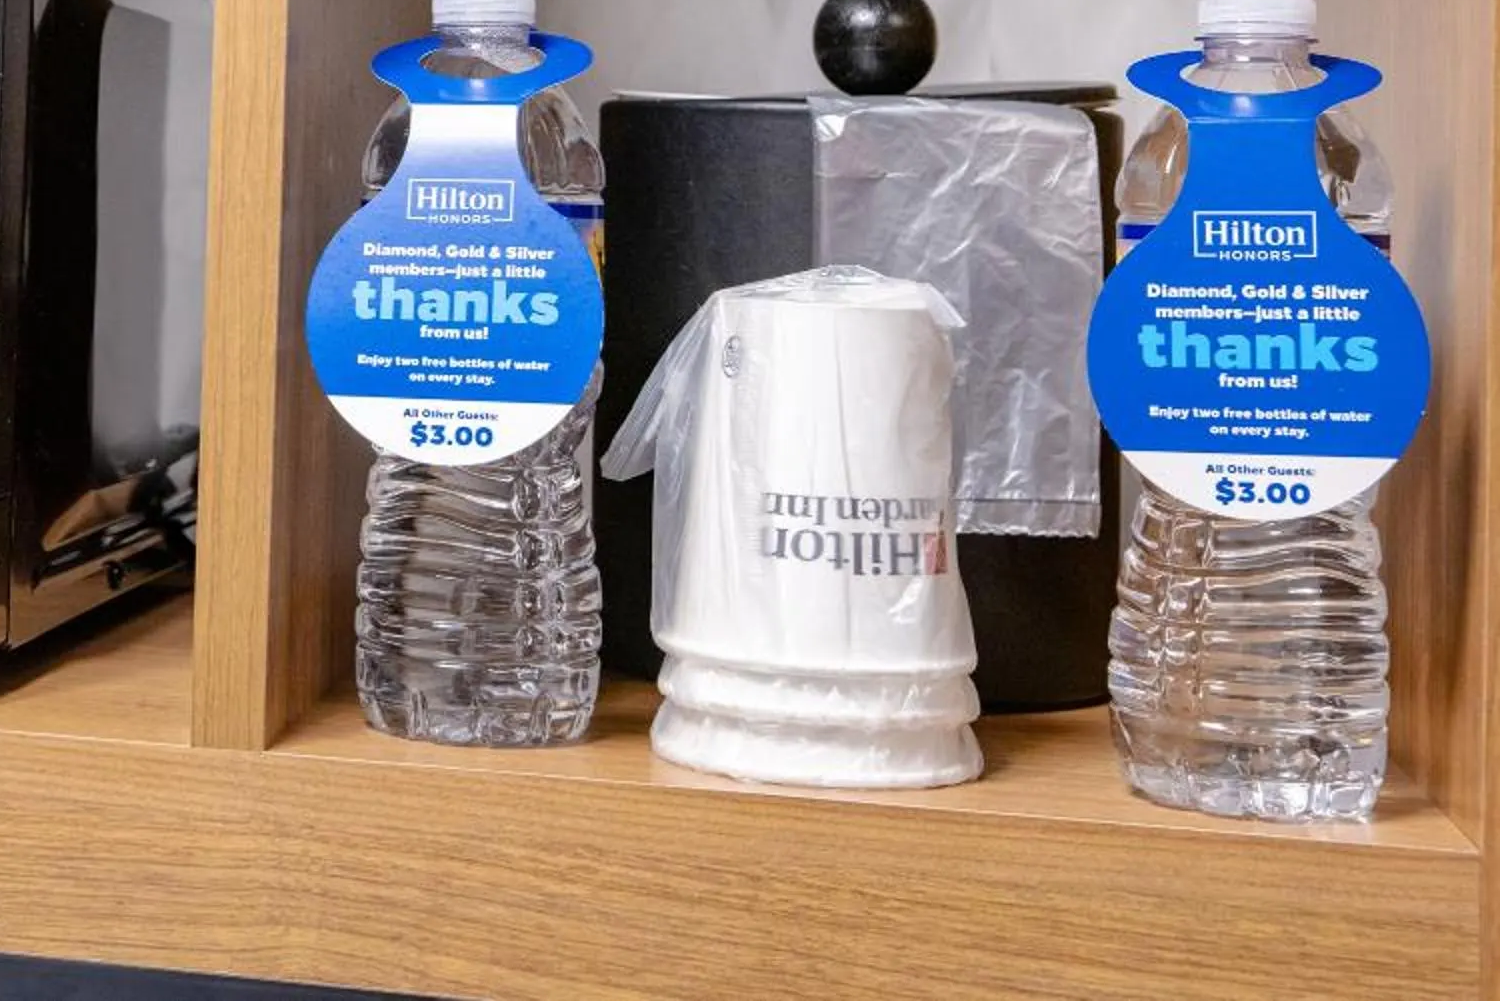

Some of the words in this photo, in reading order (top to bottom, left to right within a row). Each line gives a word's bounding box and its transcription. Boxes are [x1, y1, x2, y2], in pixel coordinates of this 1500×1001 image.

[416, 186, 504, 211] Hilton
[428, 215, 492, 224] HONORS
[1203, 220, 1306, 247] Hilton
[363, 242, 441, 259] Diamond,
[446, 244, 485, 259] Gold
[488, 245, 501, 259] &
[505, 245, 555, 260] Silver
[1219, 251, 1292, 261] HONORS
[491, 268, 503, 278] a
[505, 265, 547, 279] little
[1146, 282, 1237, 302] Diamond,
[1241, 284, 1287, 300] Gold
[1291, 285, 1306, 300] &
[1311, 285, 1369, 300] Silver
[352, 277, 560, 325] thanks
[1296, 310, 1309, 320] a
[1313, 306, 1361, 321] little
[419, 324, 461, 340] from
[463, 327, 489, 340] us!
[1137, 320, 1379, 372] thanks
[357, 354, 393, 368] Enjoy
[395, 355, 420, 367] two
[421, 356, 448, 368] free
[449, 357, 495, 369] bottles
[497, 357, 511, 370] of
[513, 360, 551, 371] water
[408, 373, 426, 383] on
[428, 374, 464, 385] every
[465, 374, 496, 386] stay.
[1218, 373, 1265, 388] from
[1269, 375, 1299, 389] us!
[403, 408, 419, 418] All
[421, 409, 454, 419] Other
[457, 410, 499, 421] Guests:
[1149, 405, 1189, 420] Enjoy
[1192, 407, 1220, 418] two
[1223, 407, 1252, 419] free
[1255, 408, 1308, 421] bottles
[1310, 409, 1327, 421] of
[1329, 411, 1372, 422] water
[409, 421, 493, 447] $3.00
[1209, 425, 1228, 435] on
[1231, 426, 1271, 439] every
[1274, 426, 1309, 439] stay.
[1205, 464, 1224, 474] All
[1227, 465, 1265, 475] Other
[1268, 466, 1316, 477] Guests:
[1215, 476, 1311, 505] $3.00
